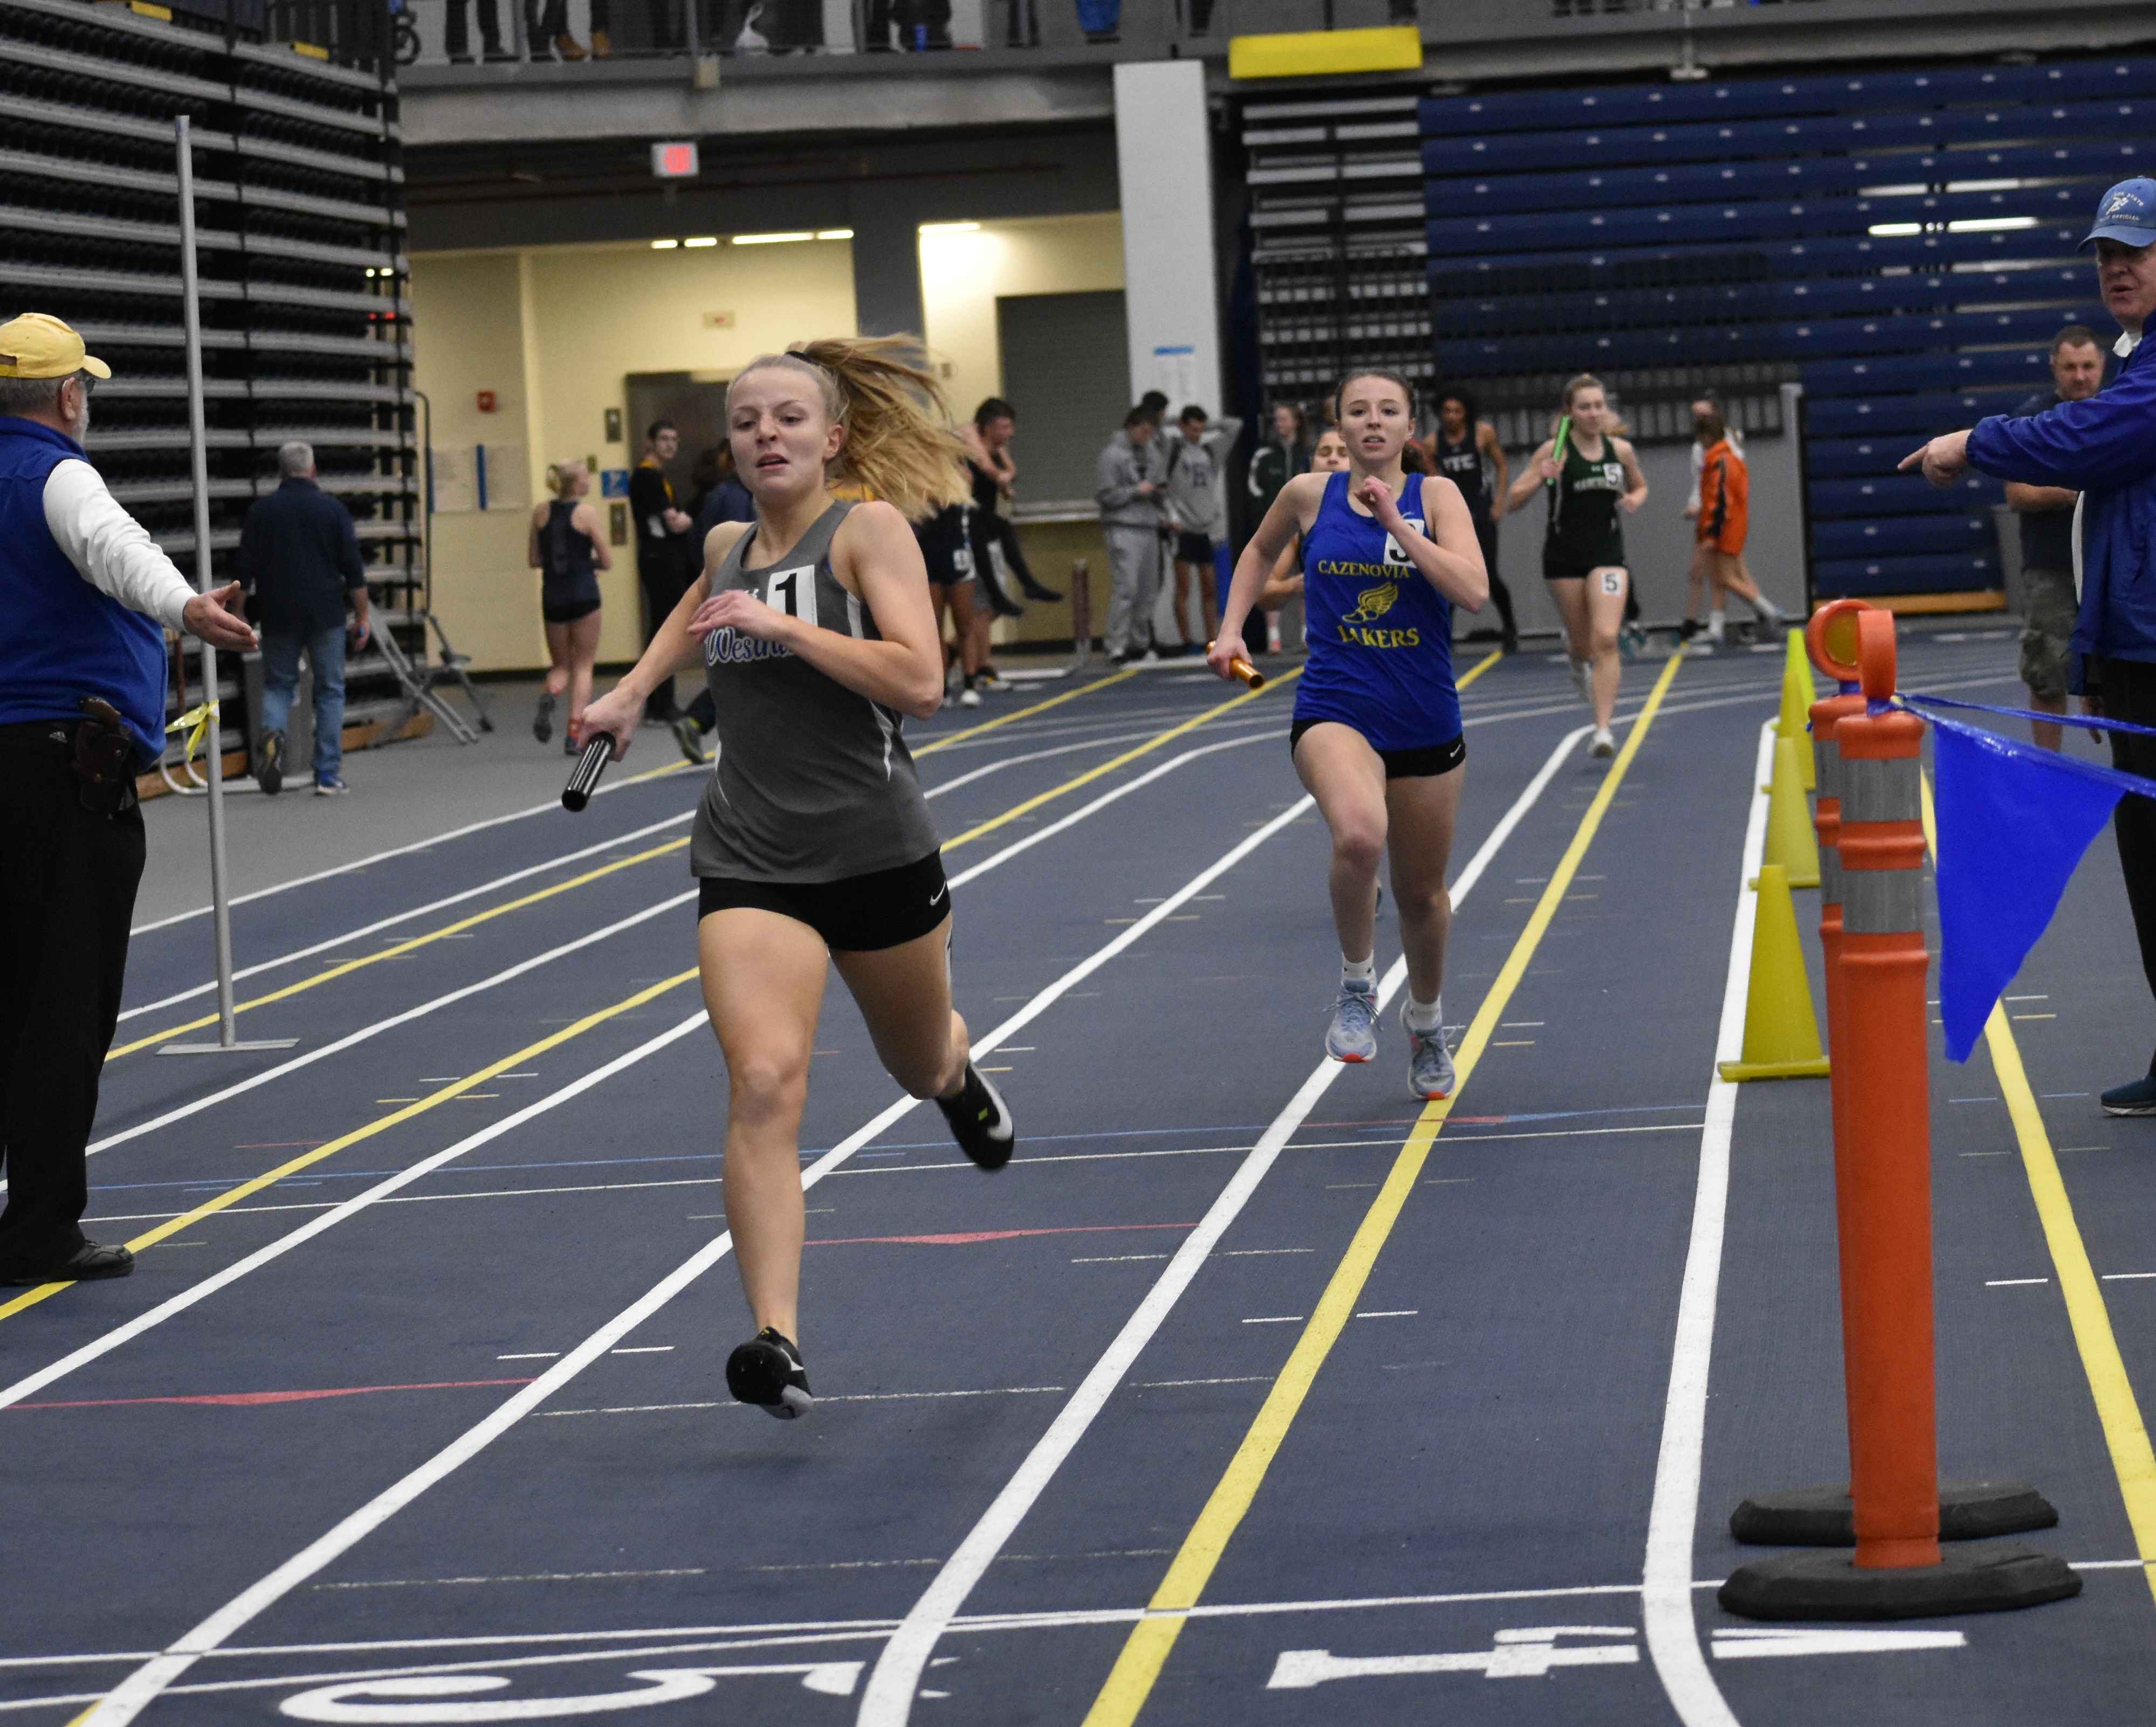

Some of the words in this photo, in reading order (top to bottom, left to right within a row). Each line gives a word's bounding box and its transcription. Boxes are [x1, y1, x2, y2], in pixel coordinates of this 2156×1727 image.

[1609, 465, 1618, 485] 5
[1318, 560, 1410, 578] CAZENOVIA
[1605, 573, 1617, 592] 5
[775, 573, 797, 618] 1
[1337, 625, 1420, 648] LAKERS
